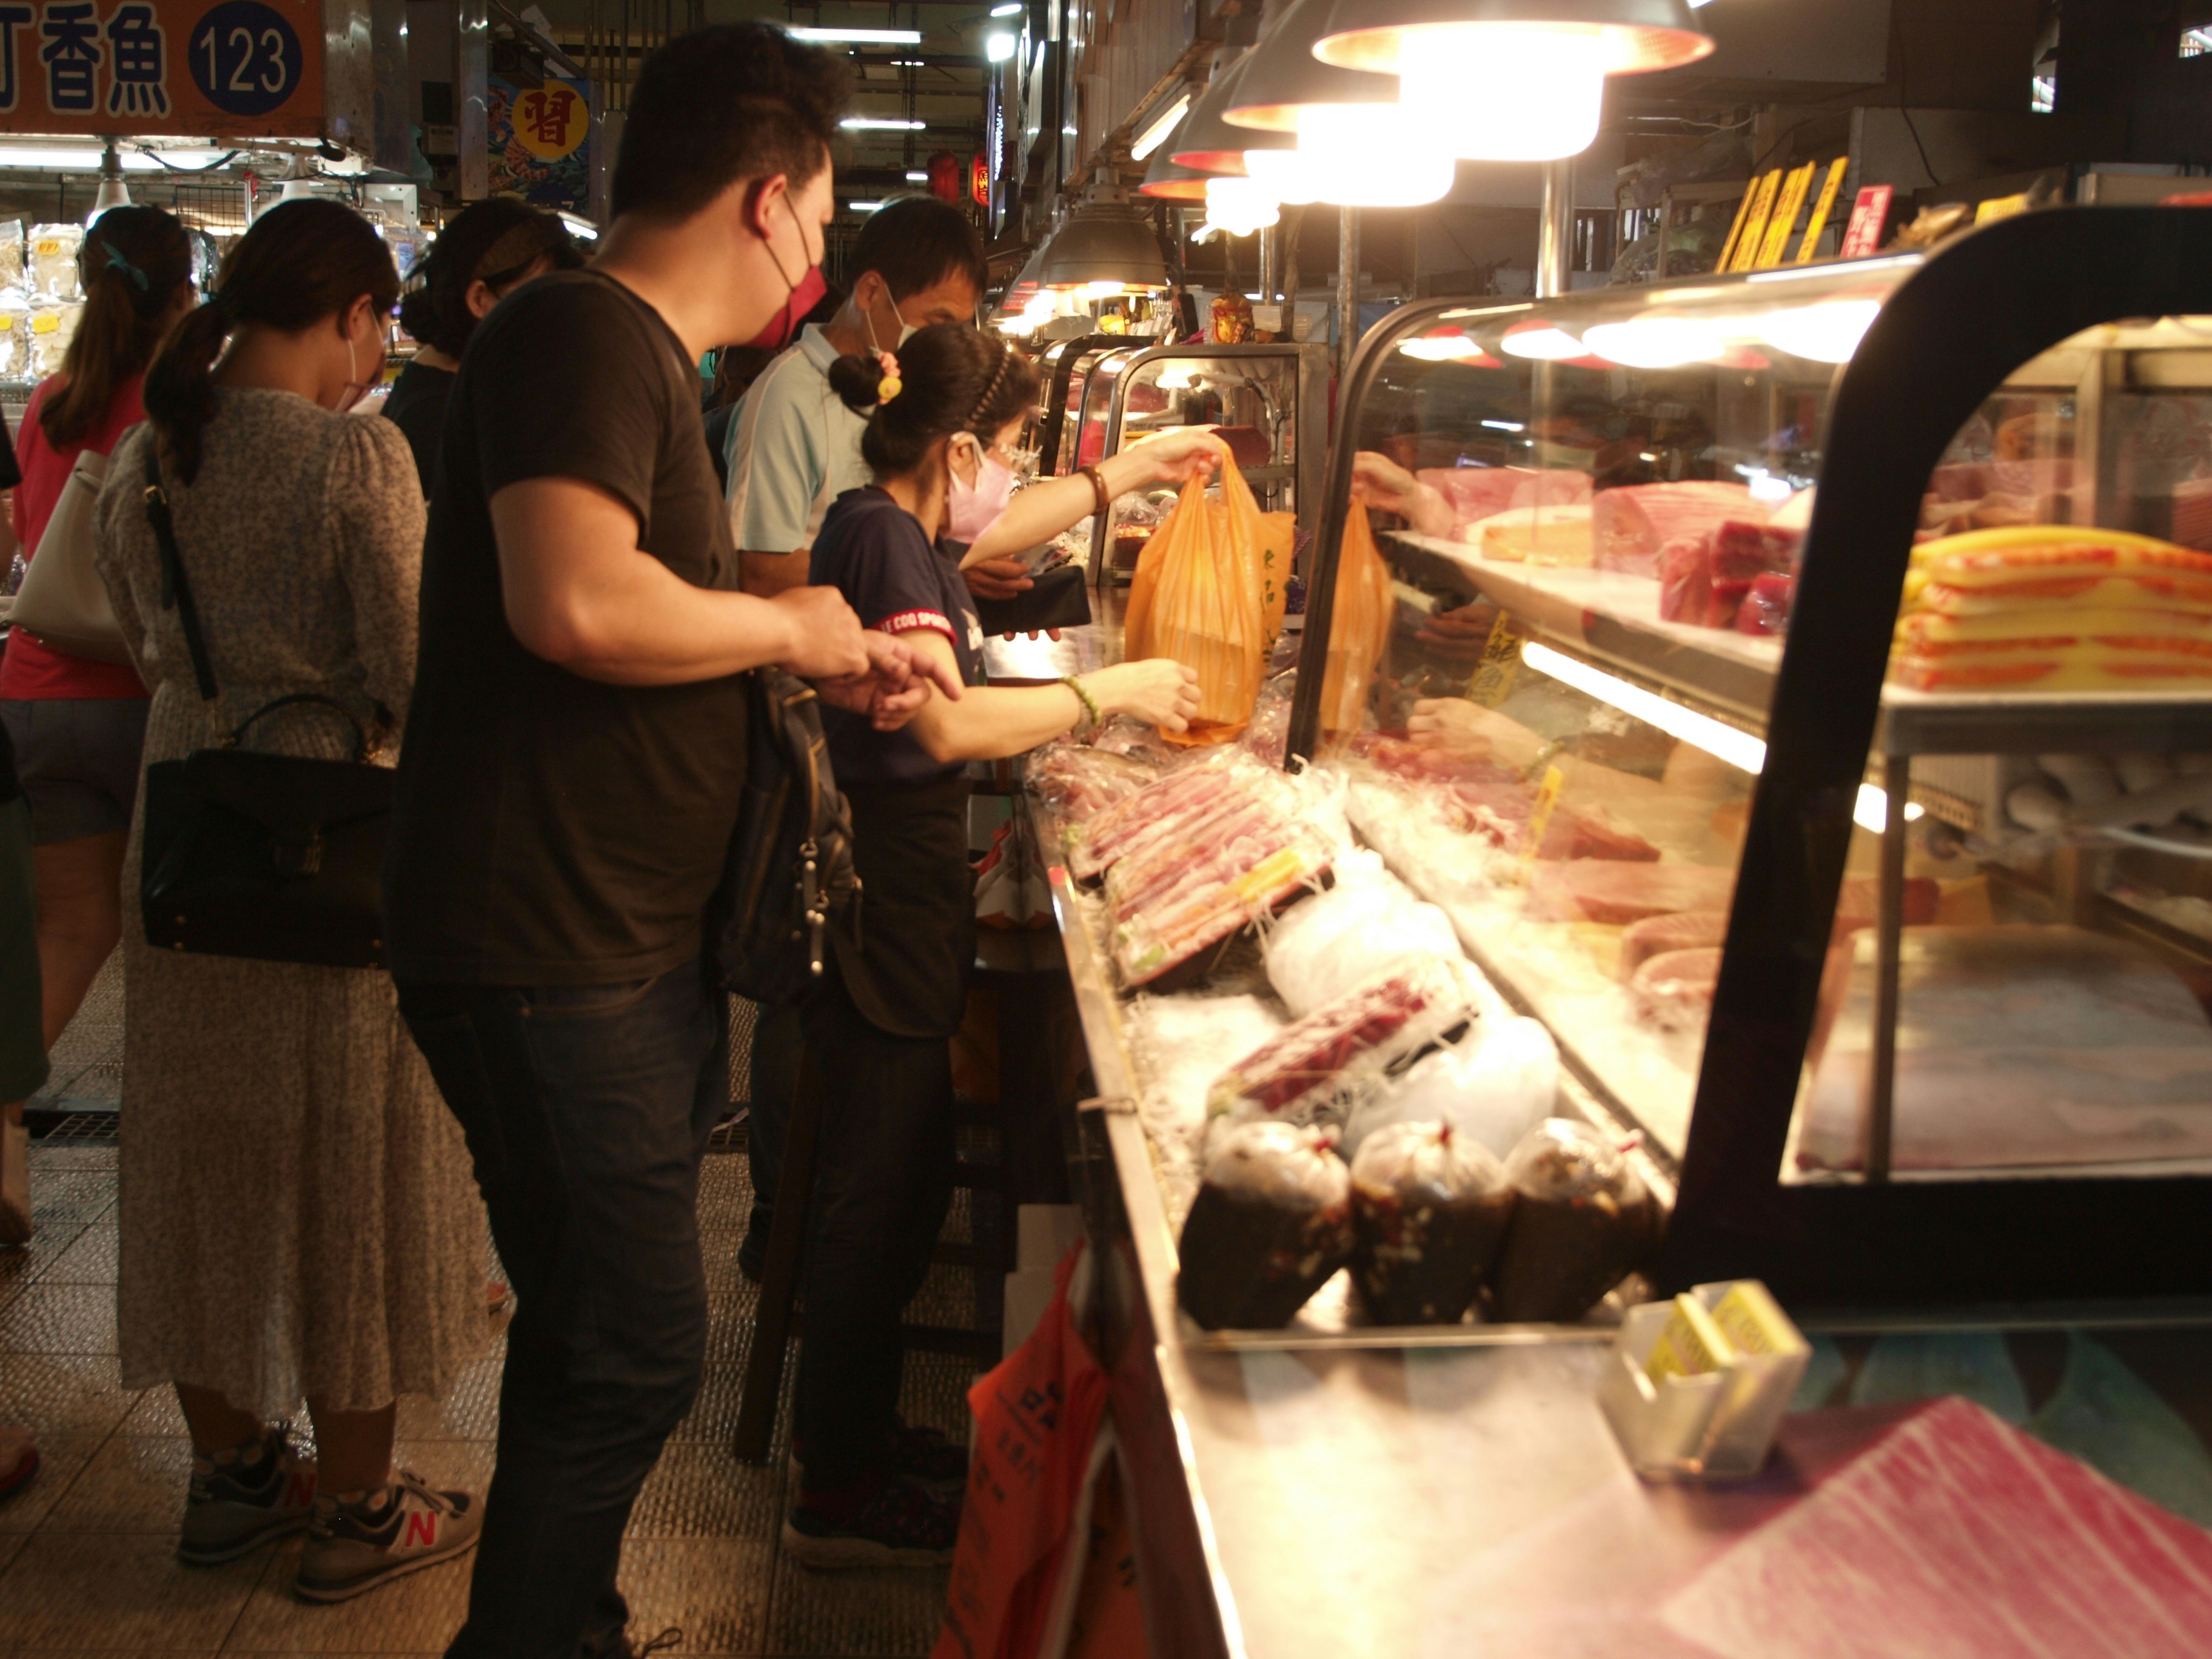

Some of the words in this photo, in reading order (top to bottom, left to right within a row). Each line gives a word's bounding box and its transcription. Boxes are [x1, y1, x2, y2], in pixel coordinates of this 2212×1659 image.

[0, 3, 167, 114] 丁香魚
[199, 26, 286, 93] 123
[525, 90, 577, 146] 習
[284, 1473, 317, 1508] N
[404, 1510, 435, 1547] N
